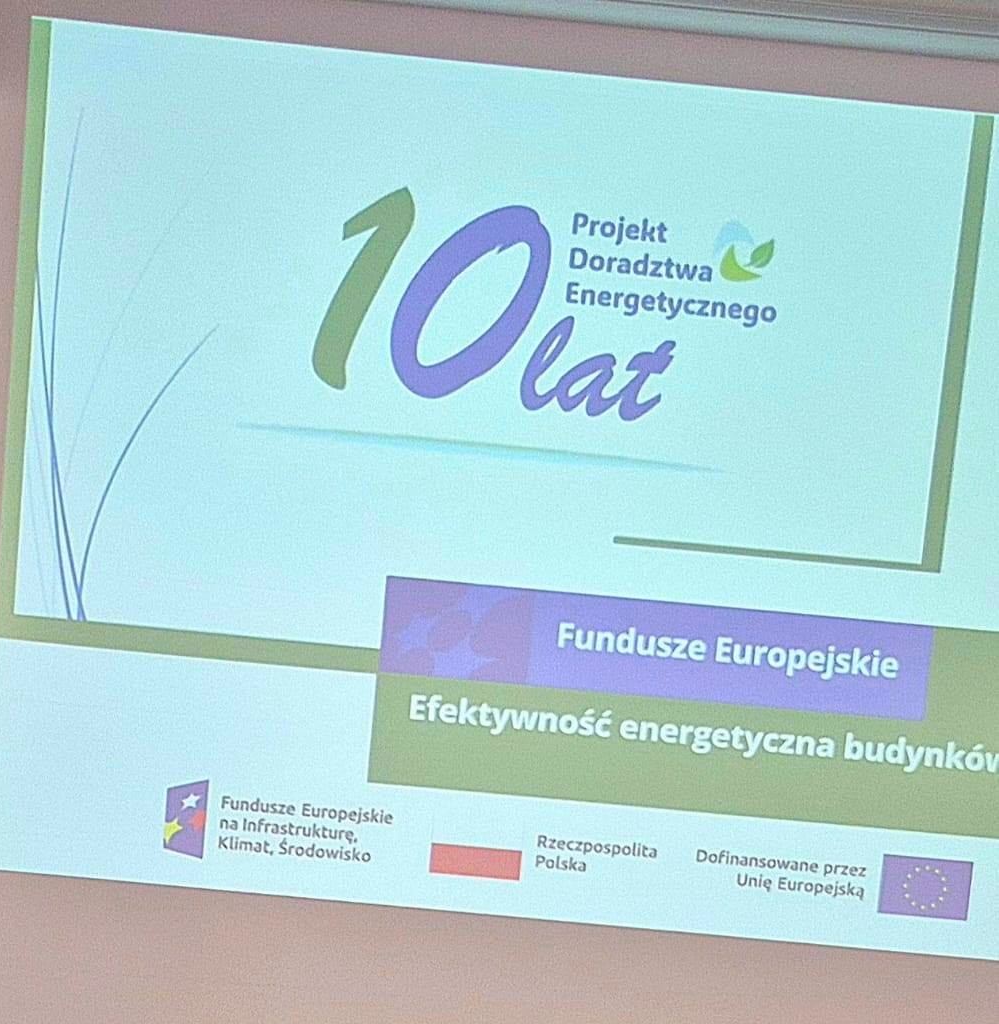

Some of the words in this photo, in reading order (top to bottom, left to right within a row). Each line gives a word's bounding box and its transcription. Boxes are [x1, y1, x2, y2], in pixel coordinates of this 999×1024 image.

[571, 212, 668, 246] Projekt
[568, 247, 713, 282] Doradztwa
[312, 186, 552, 399] 10
[520, 315, 677, 421] lat
[565, 281, 777, 328] Energetycznego
[556, 621, 706, 661] Fundusze
[715, 636, 900, 681] Europejskie
[409, 693, 613, 737] Efektywność
[619, 718, 835, 758] energetyczna
[220, 795, 296, 816] Fundusze
[301, 803, 394, 825] Europejskie
[219, 818, 239, 831] na
[242, 818, 358, 844] Infrastrukturę,
[536, 834, 658, 858] Rzeczpospolita
[218, 836, 274, 857] Klimat,
[278, 838, 372, 863] Środowisko
[535, 855, 587, 872] Polska
[696, 849, 819, 873] Dofinansowane
[823, 862, 867, 878] przez
[736, 873, 772, 893] Unię
[777, 877, 865, 901] Europejską
